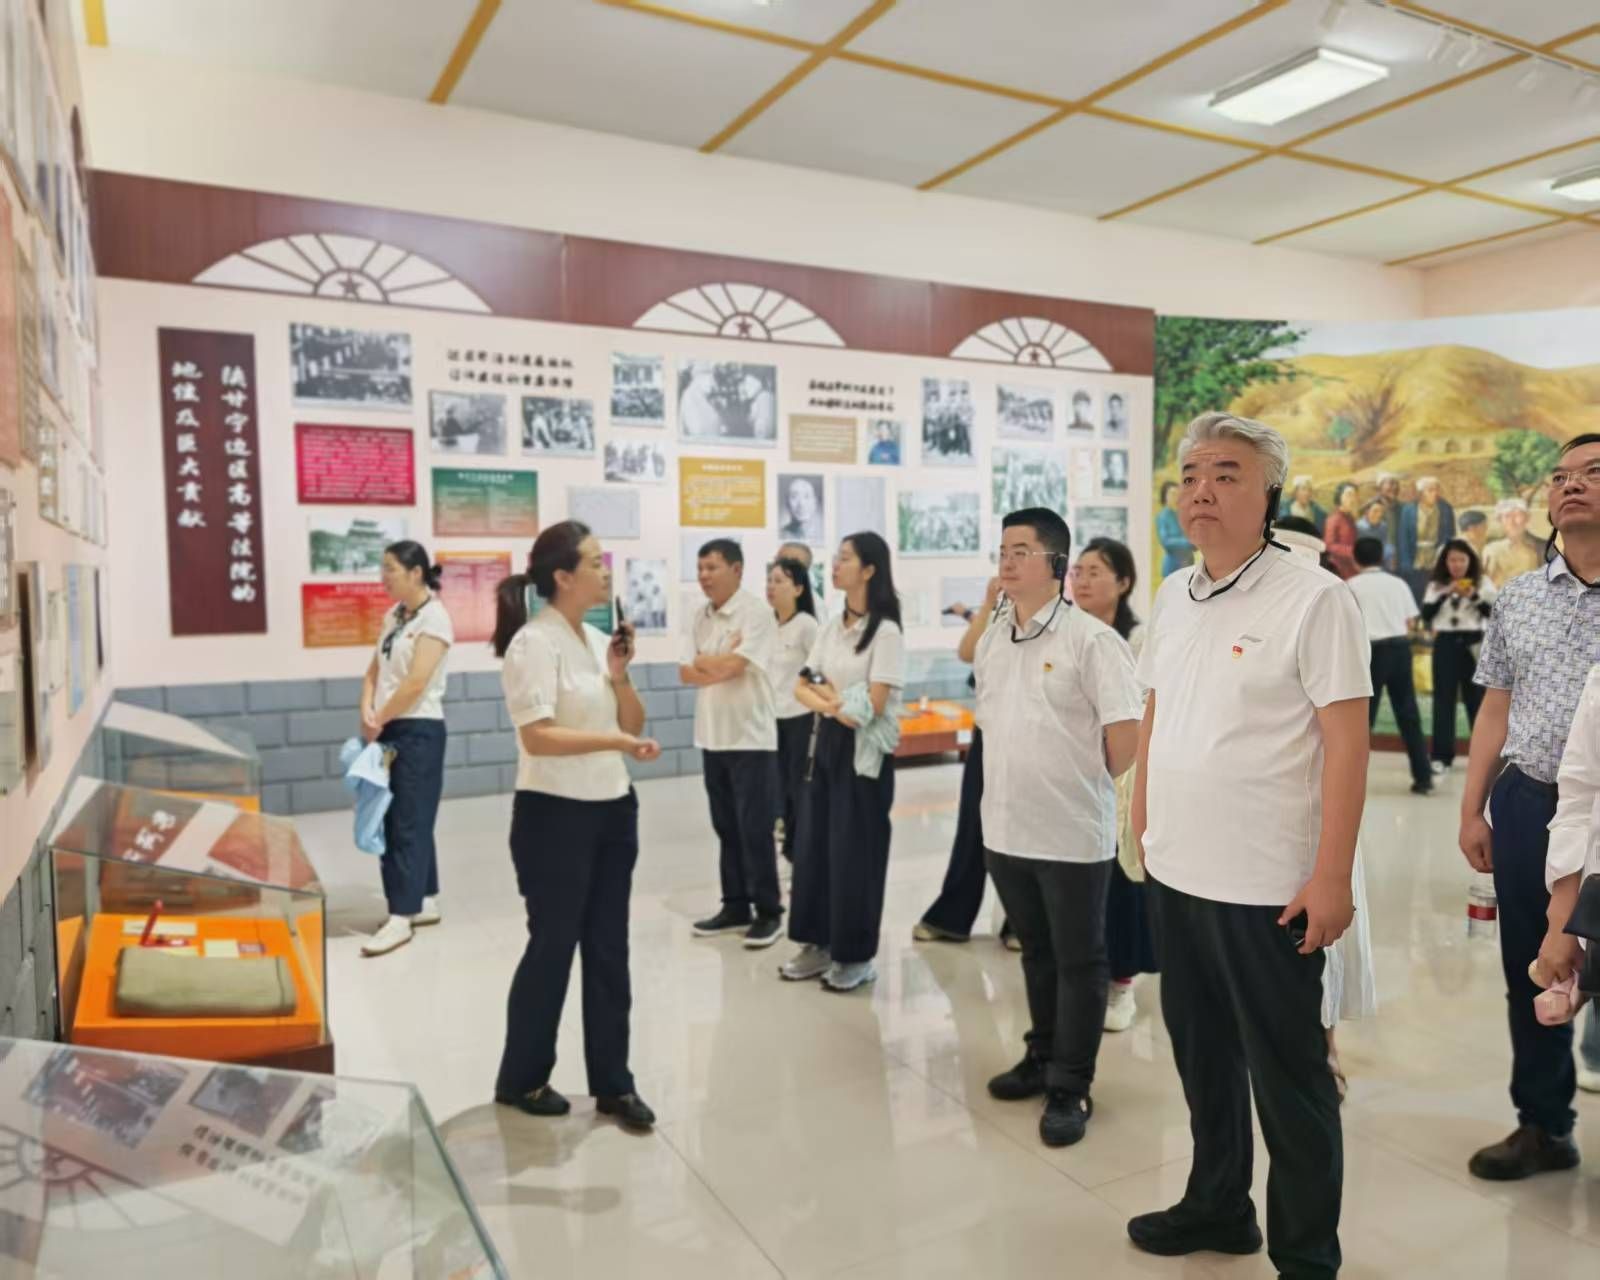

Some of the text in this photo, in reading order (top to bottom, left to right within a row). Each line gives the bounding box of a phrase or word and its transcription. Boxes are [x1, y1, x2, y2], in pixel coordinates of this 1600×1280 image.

[172, 361, 206, 528] 地位及巨大贡献
[221, 365, 257, 602] 陕甘宁边区高等法院的
